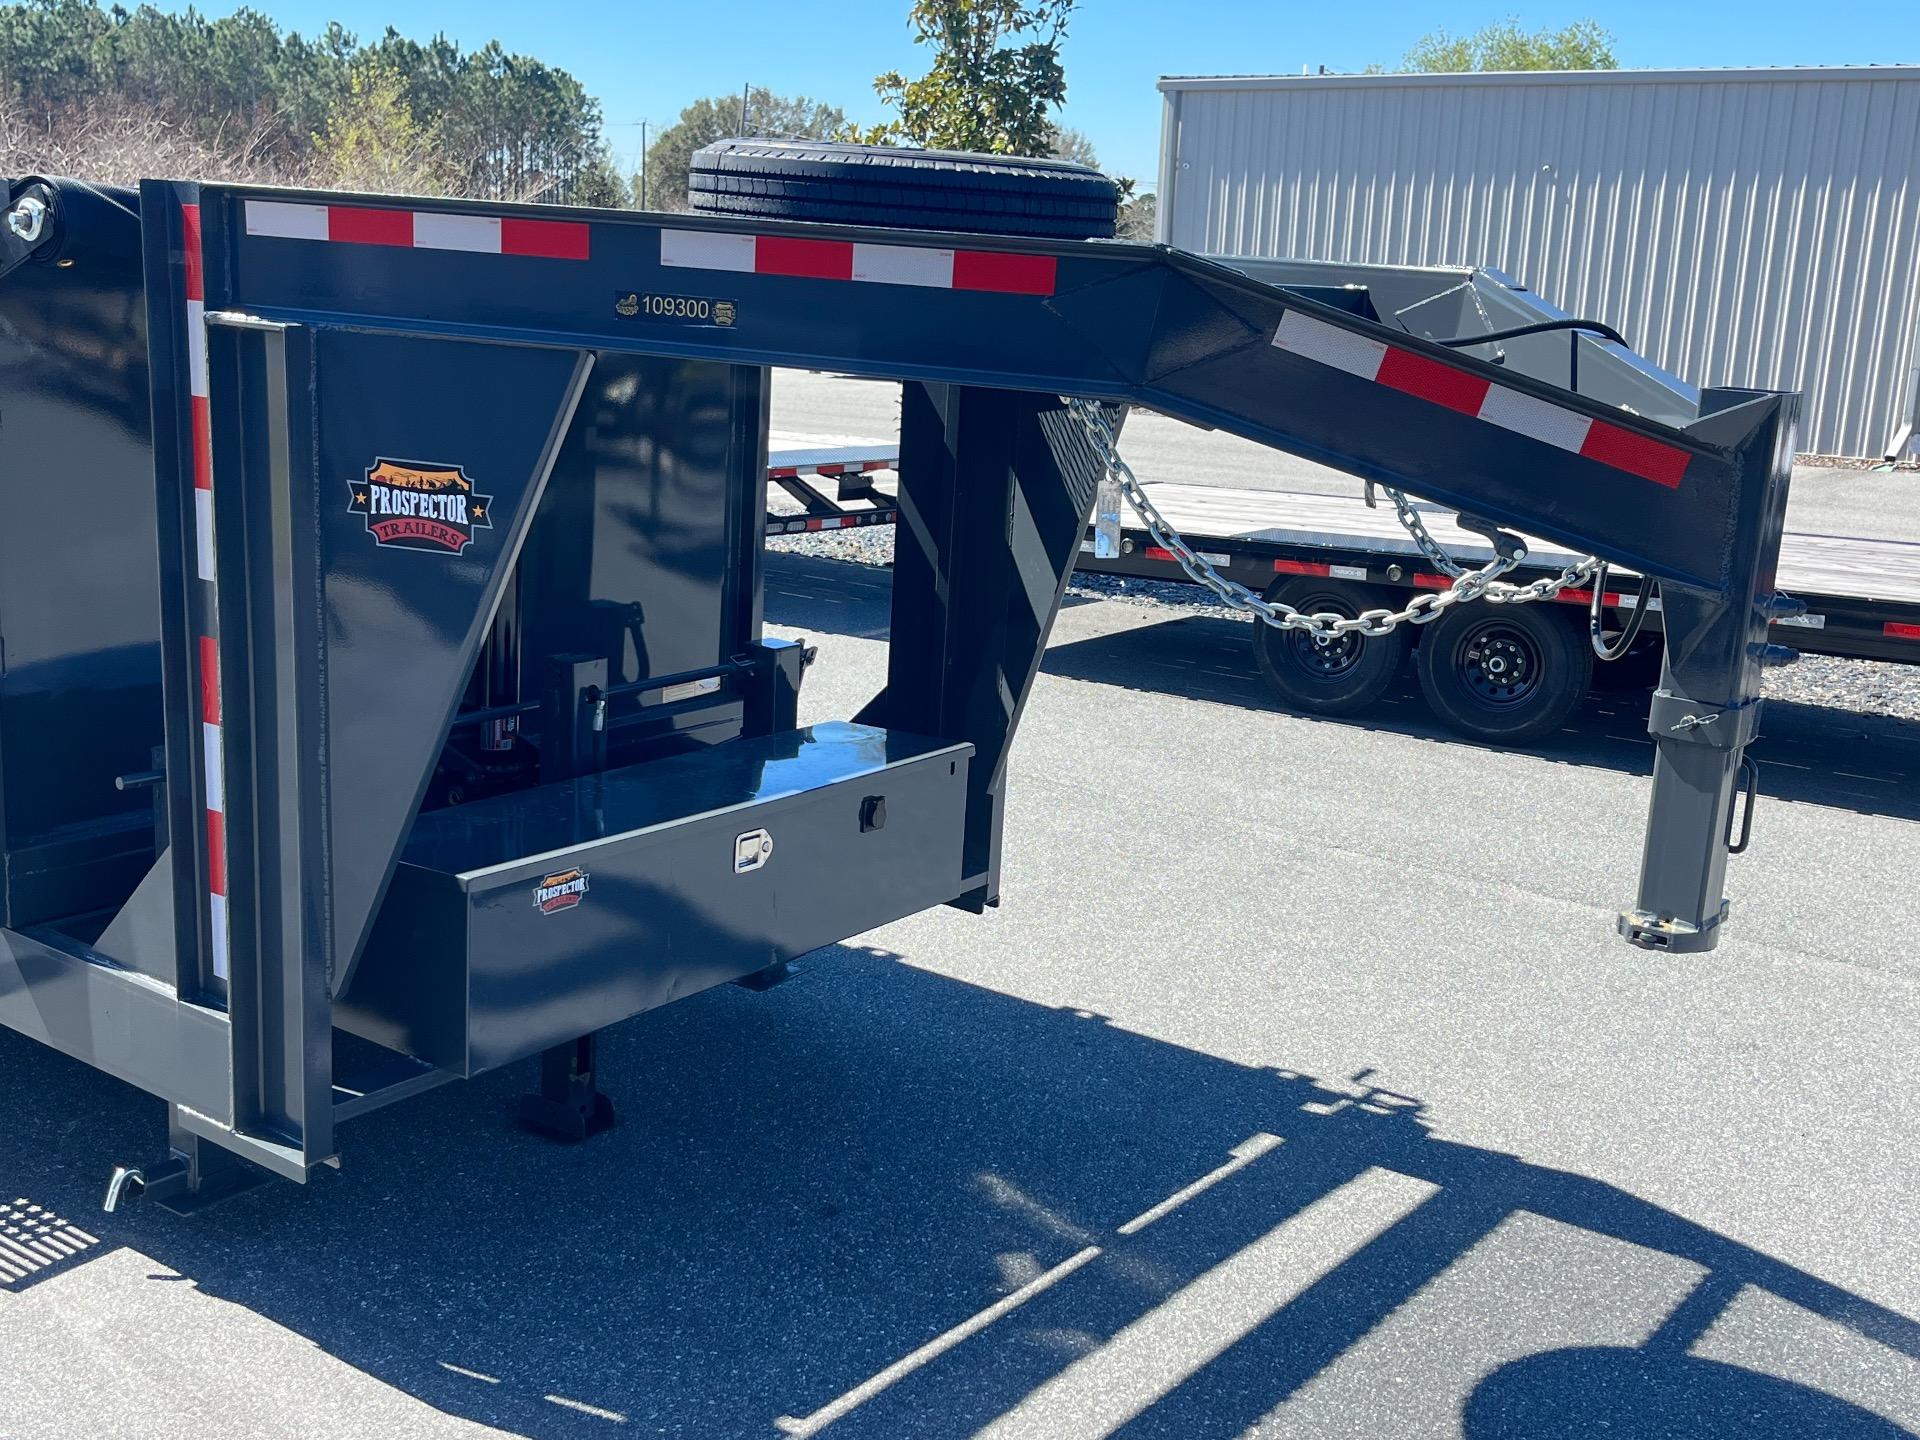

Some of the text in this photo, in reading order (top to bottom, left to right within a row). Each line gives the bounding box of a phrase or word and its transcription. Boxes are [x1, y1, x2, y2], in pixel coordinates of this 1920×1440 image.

[643, 296, 709, 319] 109300
[370, 485, 469, 525] PROSPECTOR
[380, 522, 460, 546] TRAILERS
[537, 878, 585, 903] PROSPECTOR
